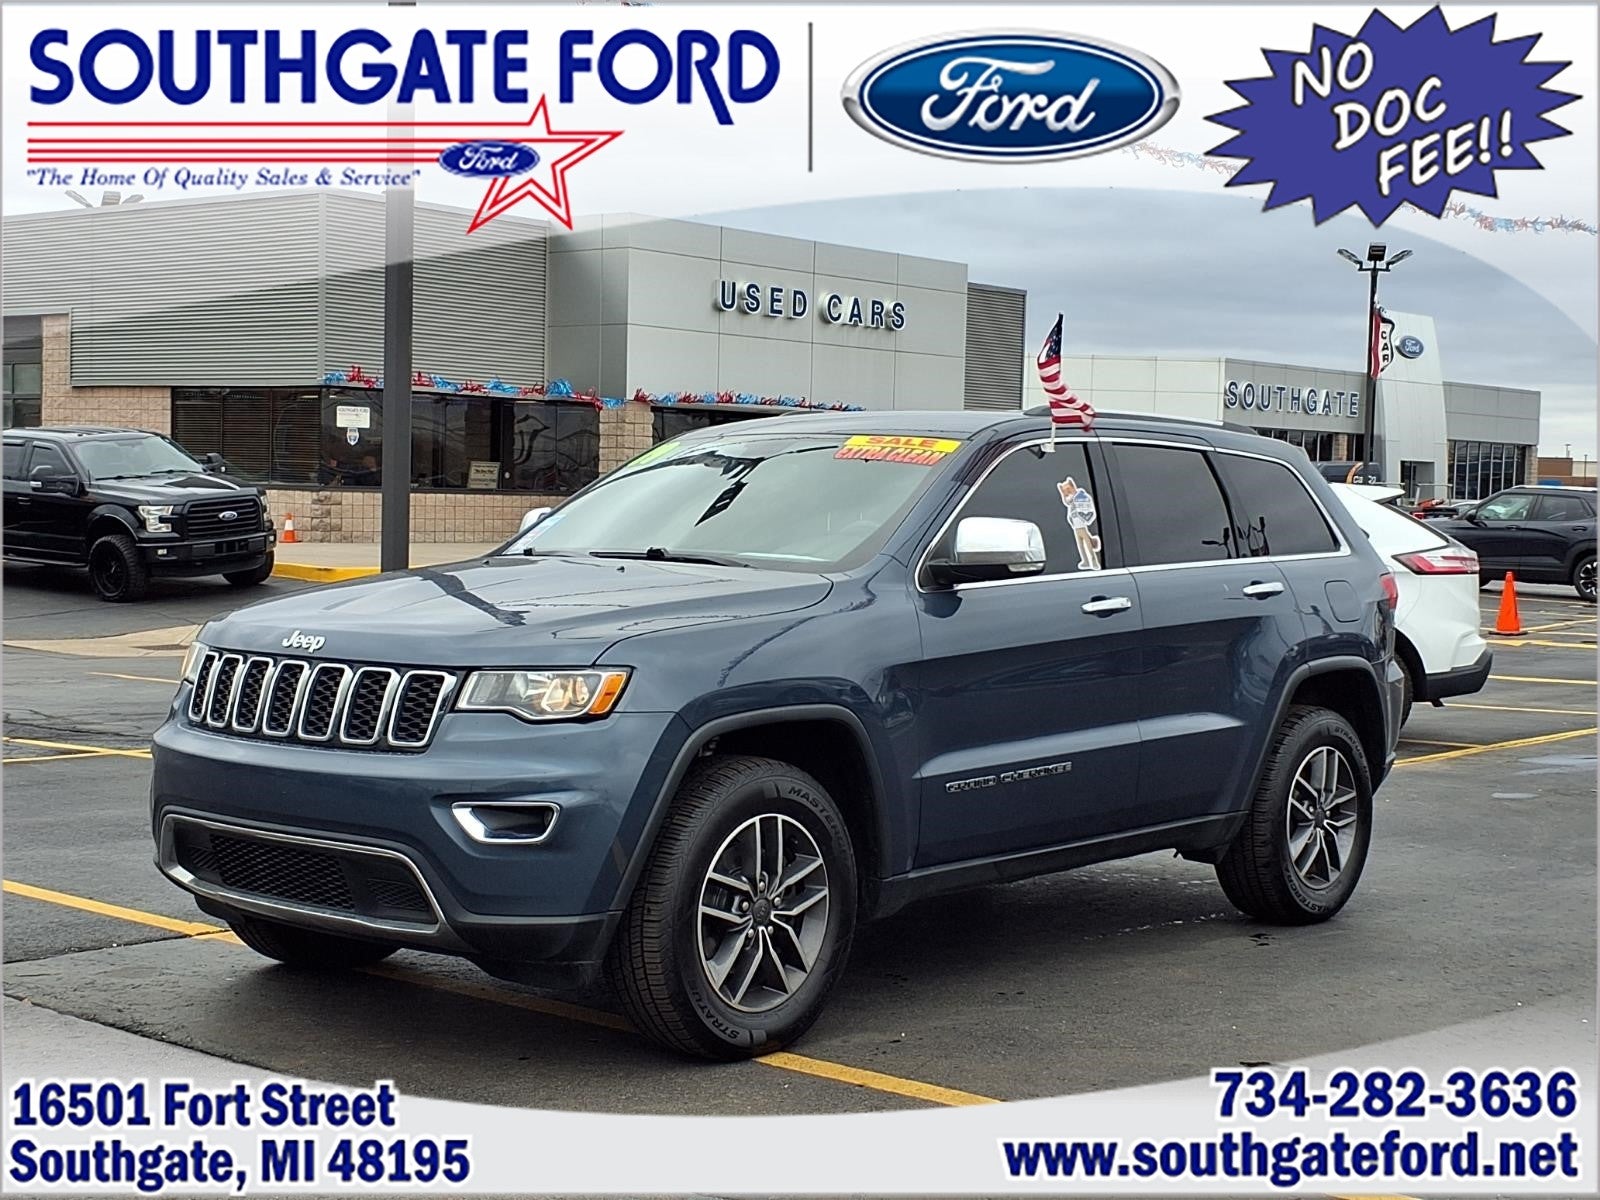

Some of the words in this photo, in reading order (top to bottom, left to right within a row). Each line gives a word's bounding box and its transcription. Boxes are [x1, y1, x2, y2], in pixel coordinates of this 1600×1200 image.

[718, 280, 808, 319] USED
[824, 293, 906, 330] CARS
[1226, 380, 1360, 417] SOUTHGATE
[865, 436, 939, 448] SALE
[281, 629, 326, 653] Jeep
[946, 776, 998, 792] GRAND
[1001, 761, 1073, 783] CHEROKEE
